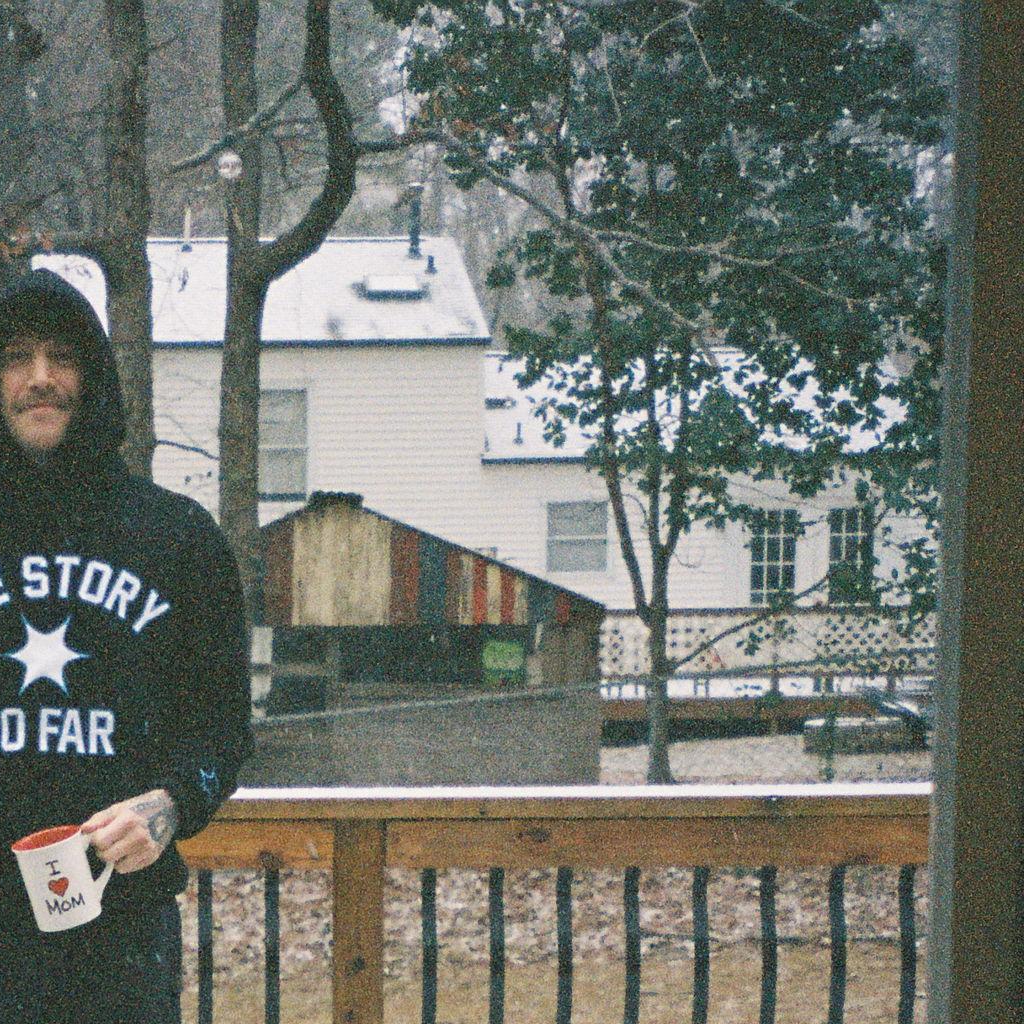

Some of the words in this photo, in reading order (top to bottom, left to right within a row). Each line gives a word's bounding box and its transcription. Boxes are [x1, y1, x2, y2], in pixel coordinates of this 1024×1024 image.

[22, 555, 171, 633] STORY
[38, 708, 115, 754] FAR
[45, 859, 61, 876] I
